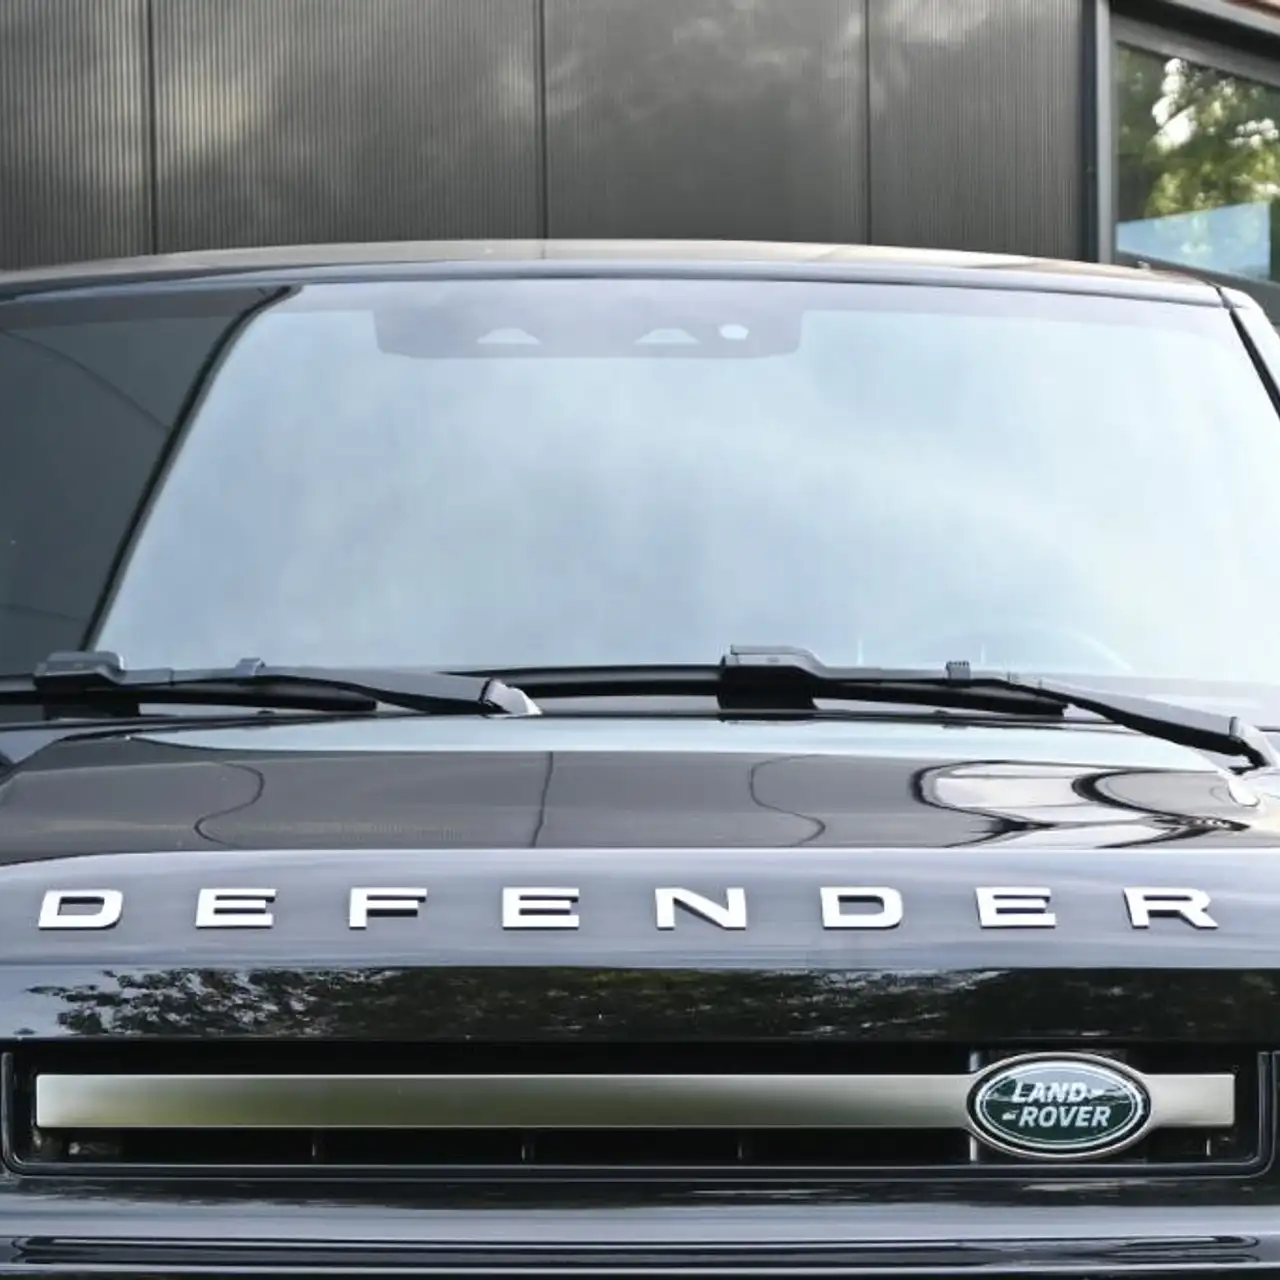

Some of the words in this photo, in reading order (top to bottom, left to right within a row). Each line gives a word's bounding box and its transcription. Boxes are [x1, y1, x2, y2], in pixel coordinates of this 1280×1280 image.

[36, 886, 1219, 929] DEFENDER
[1012, 1081, 1088, 1104] LAND
[1018, 1105, 1112, 1128] ROVER
